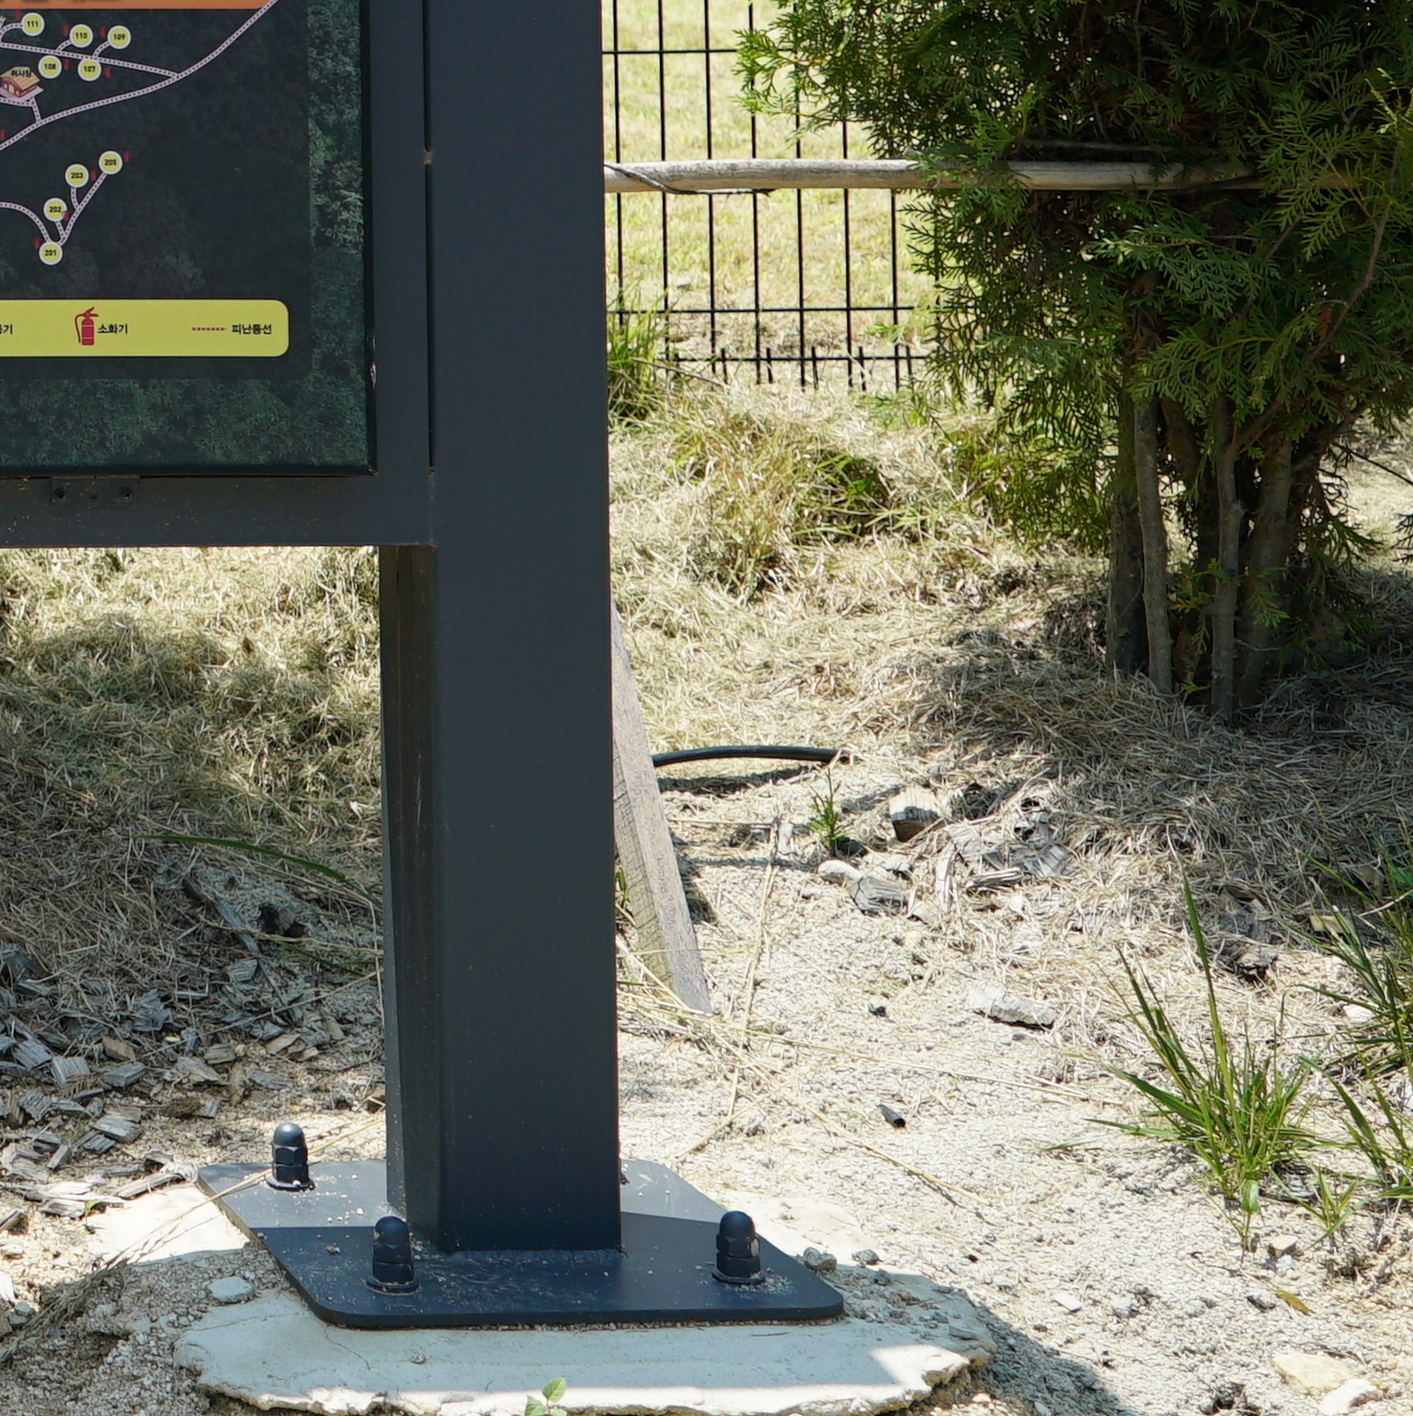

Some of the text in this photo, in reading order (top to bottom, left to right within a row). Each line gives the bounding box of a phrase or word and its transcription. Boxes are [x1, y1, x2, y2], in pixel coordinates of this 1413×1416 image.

[26, 20, 39, 28] 111
[75, 32, 88, 40] 110
[83, 65, 96, 73] 107
[104, 158, 117, 166] 205
[49, 205, 62, 213] 202
[44, 249, 57, 257] 201
[97, 323, 128, 334] 소화기
